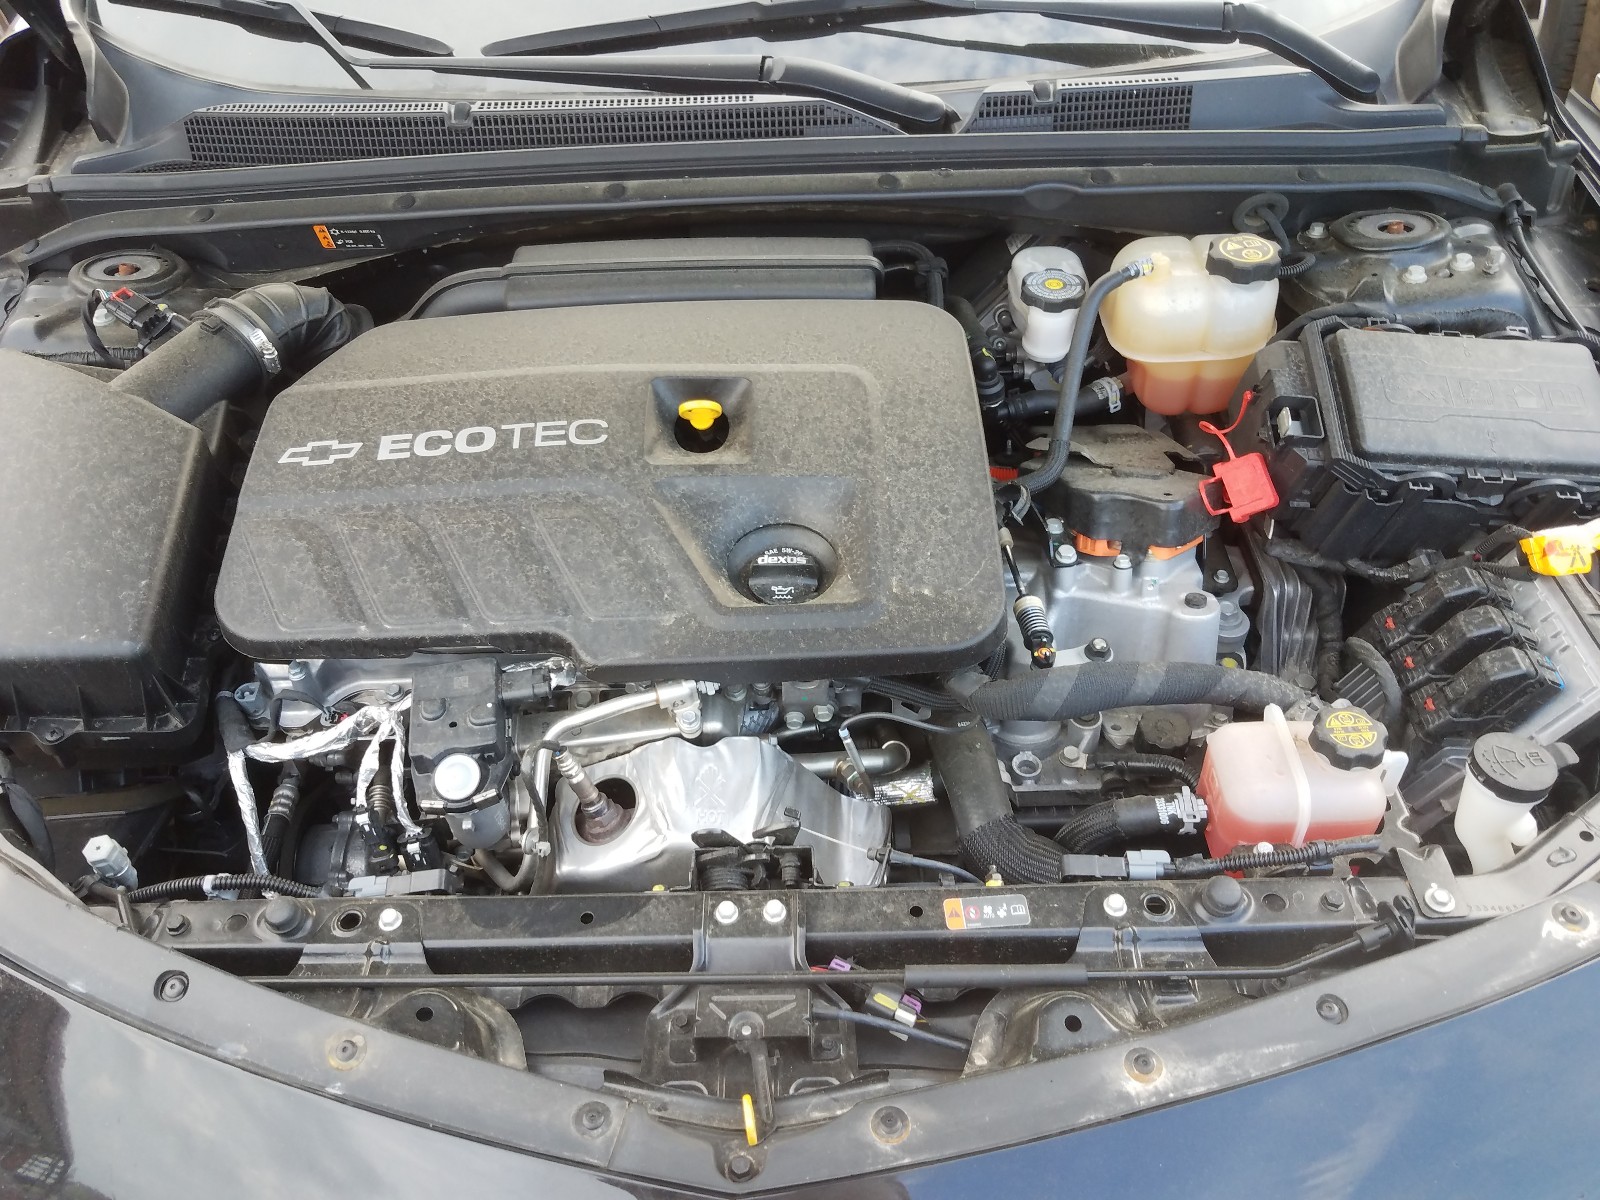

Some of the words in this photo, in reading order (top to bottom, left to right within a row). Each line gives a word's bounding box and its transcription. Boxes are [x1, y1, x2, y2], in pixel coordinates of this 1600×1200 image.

[376, 418, 609, 461] ECOTEC
[757, 554, 807, 565] dexos
[696, 809, 726, 825] HOT
